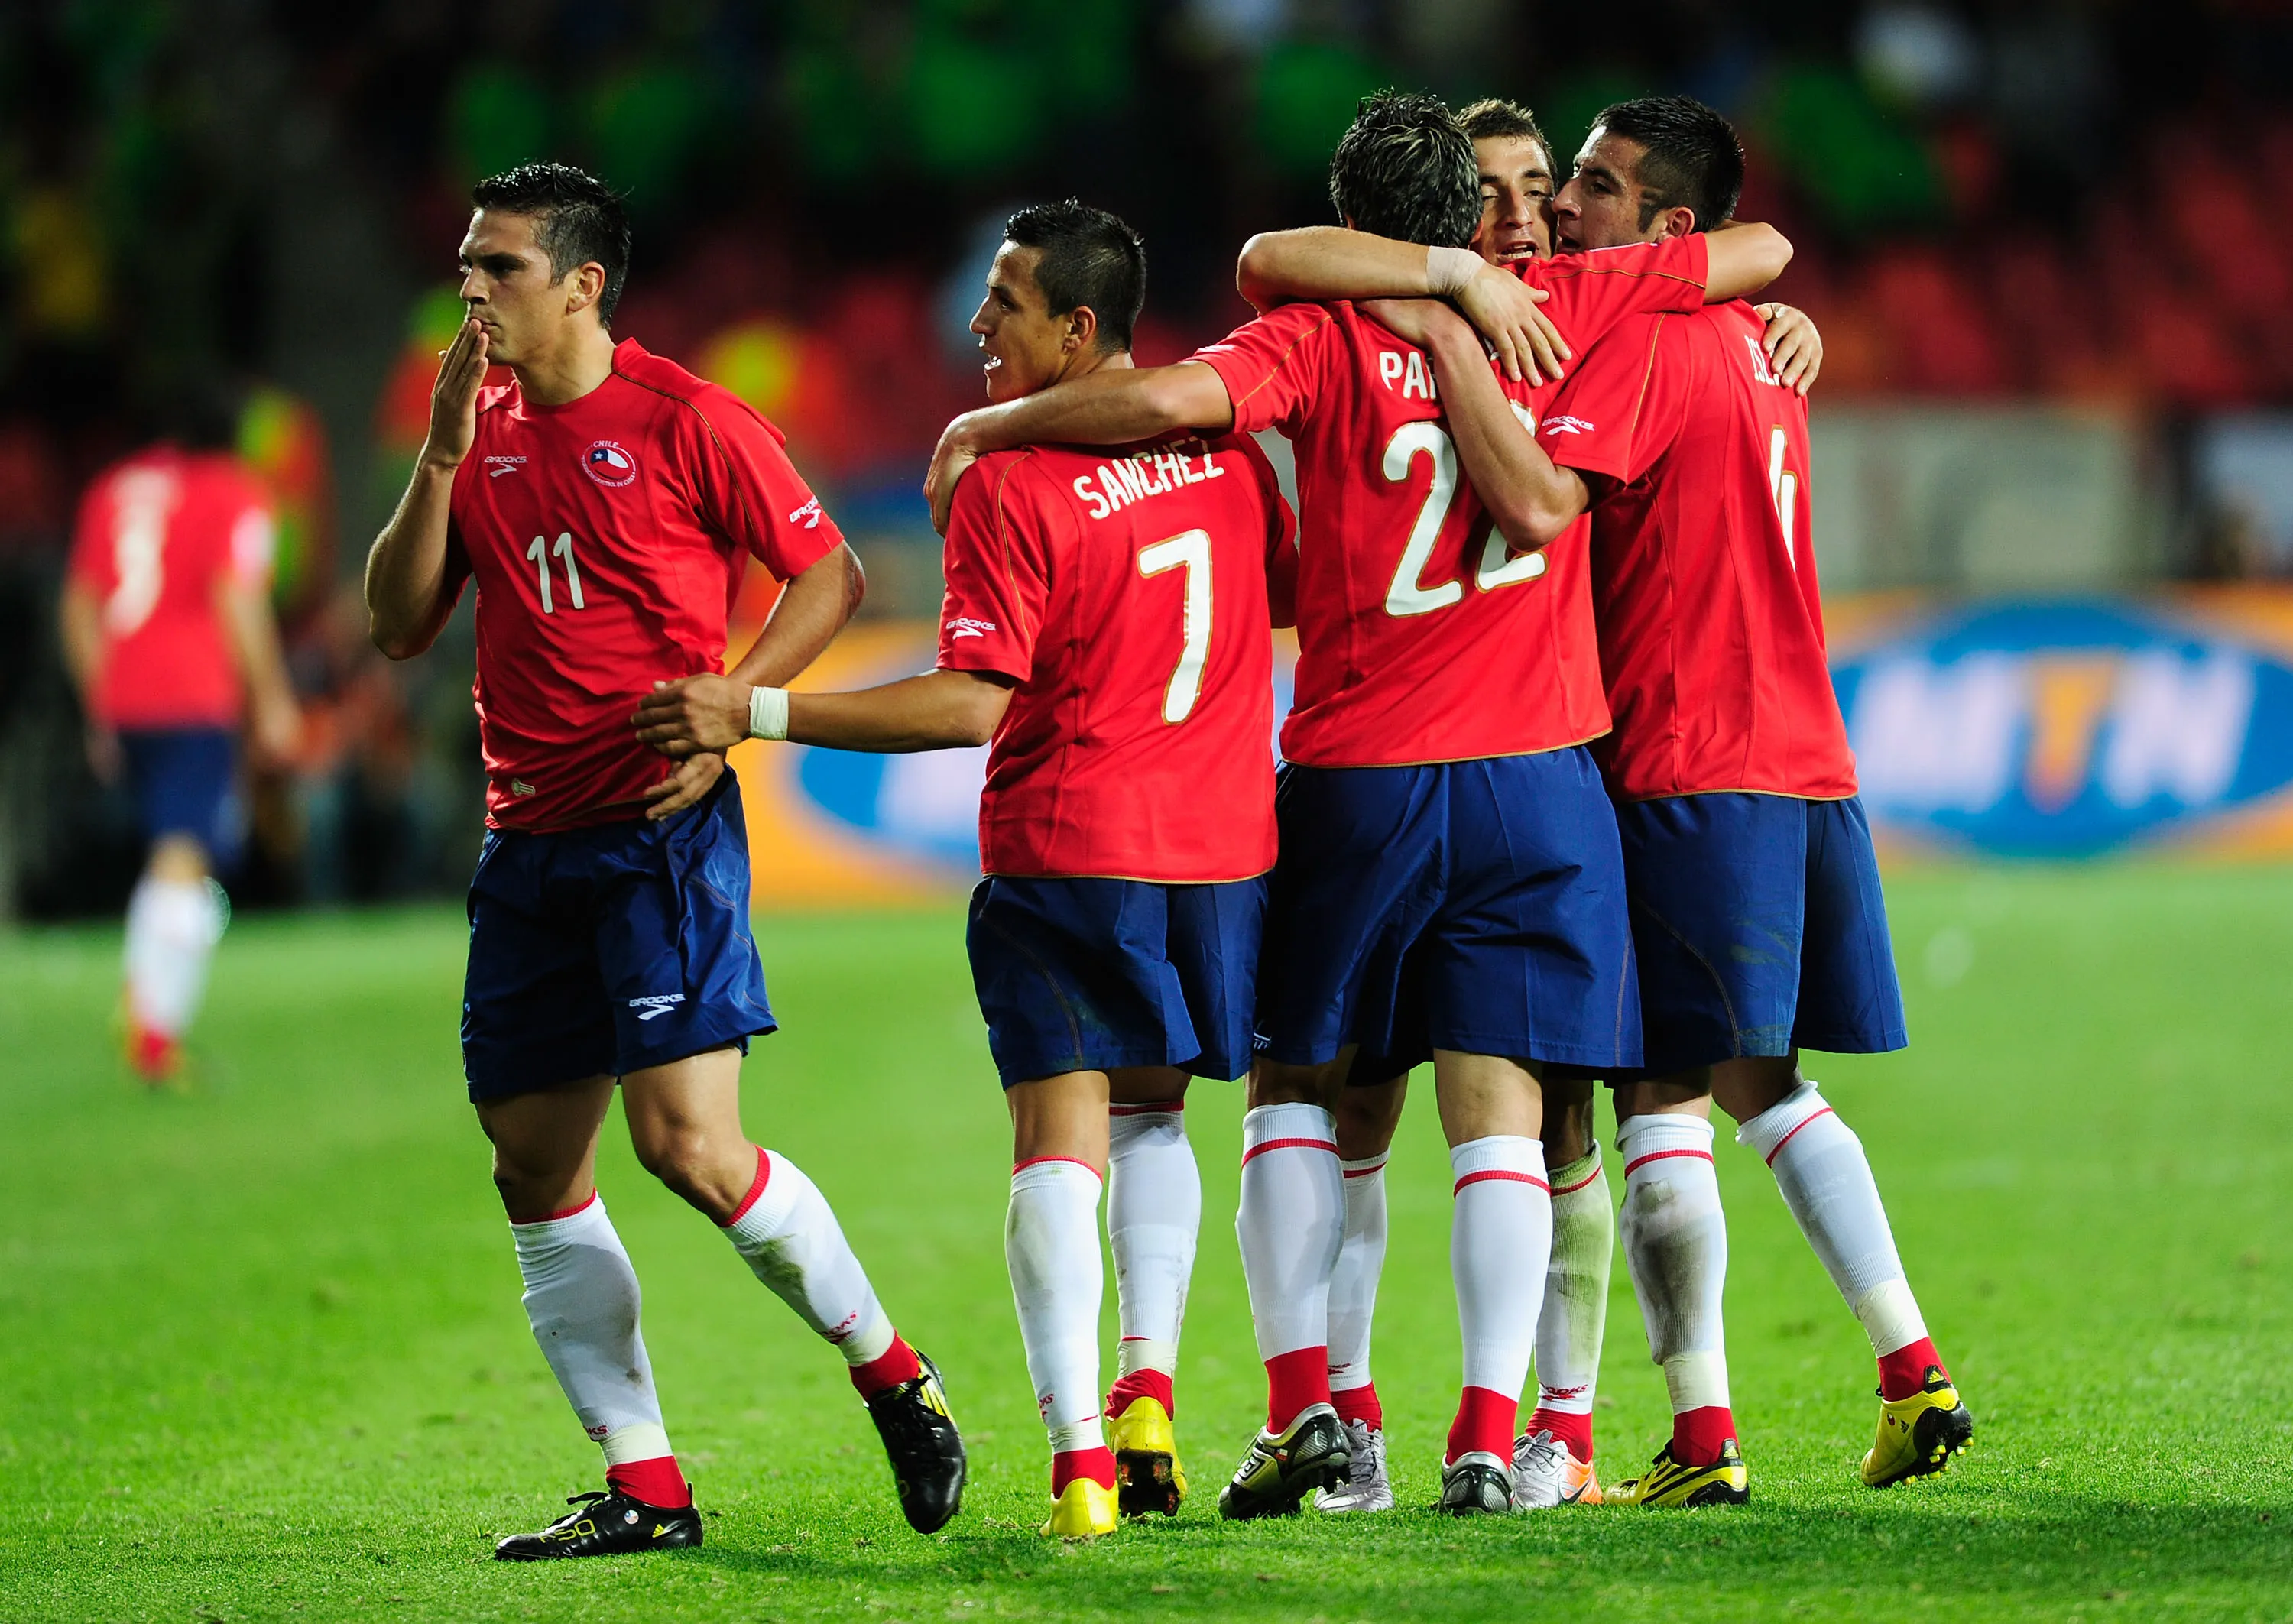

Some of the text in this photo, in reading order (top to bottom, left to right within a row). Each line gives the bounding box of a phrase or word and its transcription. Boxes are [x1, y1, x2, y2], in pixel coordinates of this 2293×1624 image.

[592, 440, 619, 449] CHILE
[1542, 415, 1595, 432] BROOKS
[1073, 436, 1225, 520] SANCHEZ
[527, 532, 585, 614] 11
[946, 618, 997, 631] BROOKS
[1137, 528, 1214, 725] 7
[1853, 648, 2255, 813] MTN
[629, 994, 686, 1006] BROOKS
